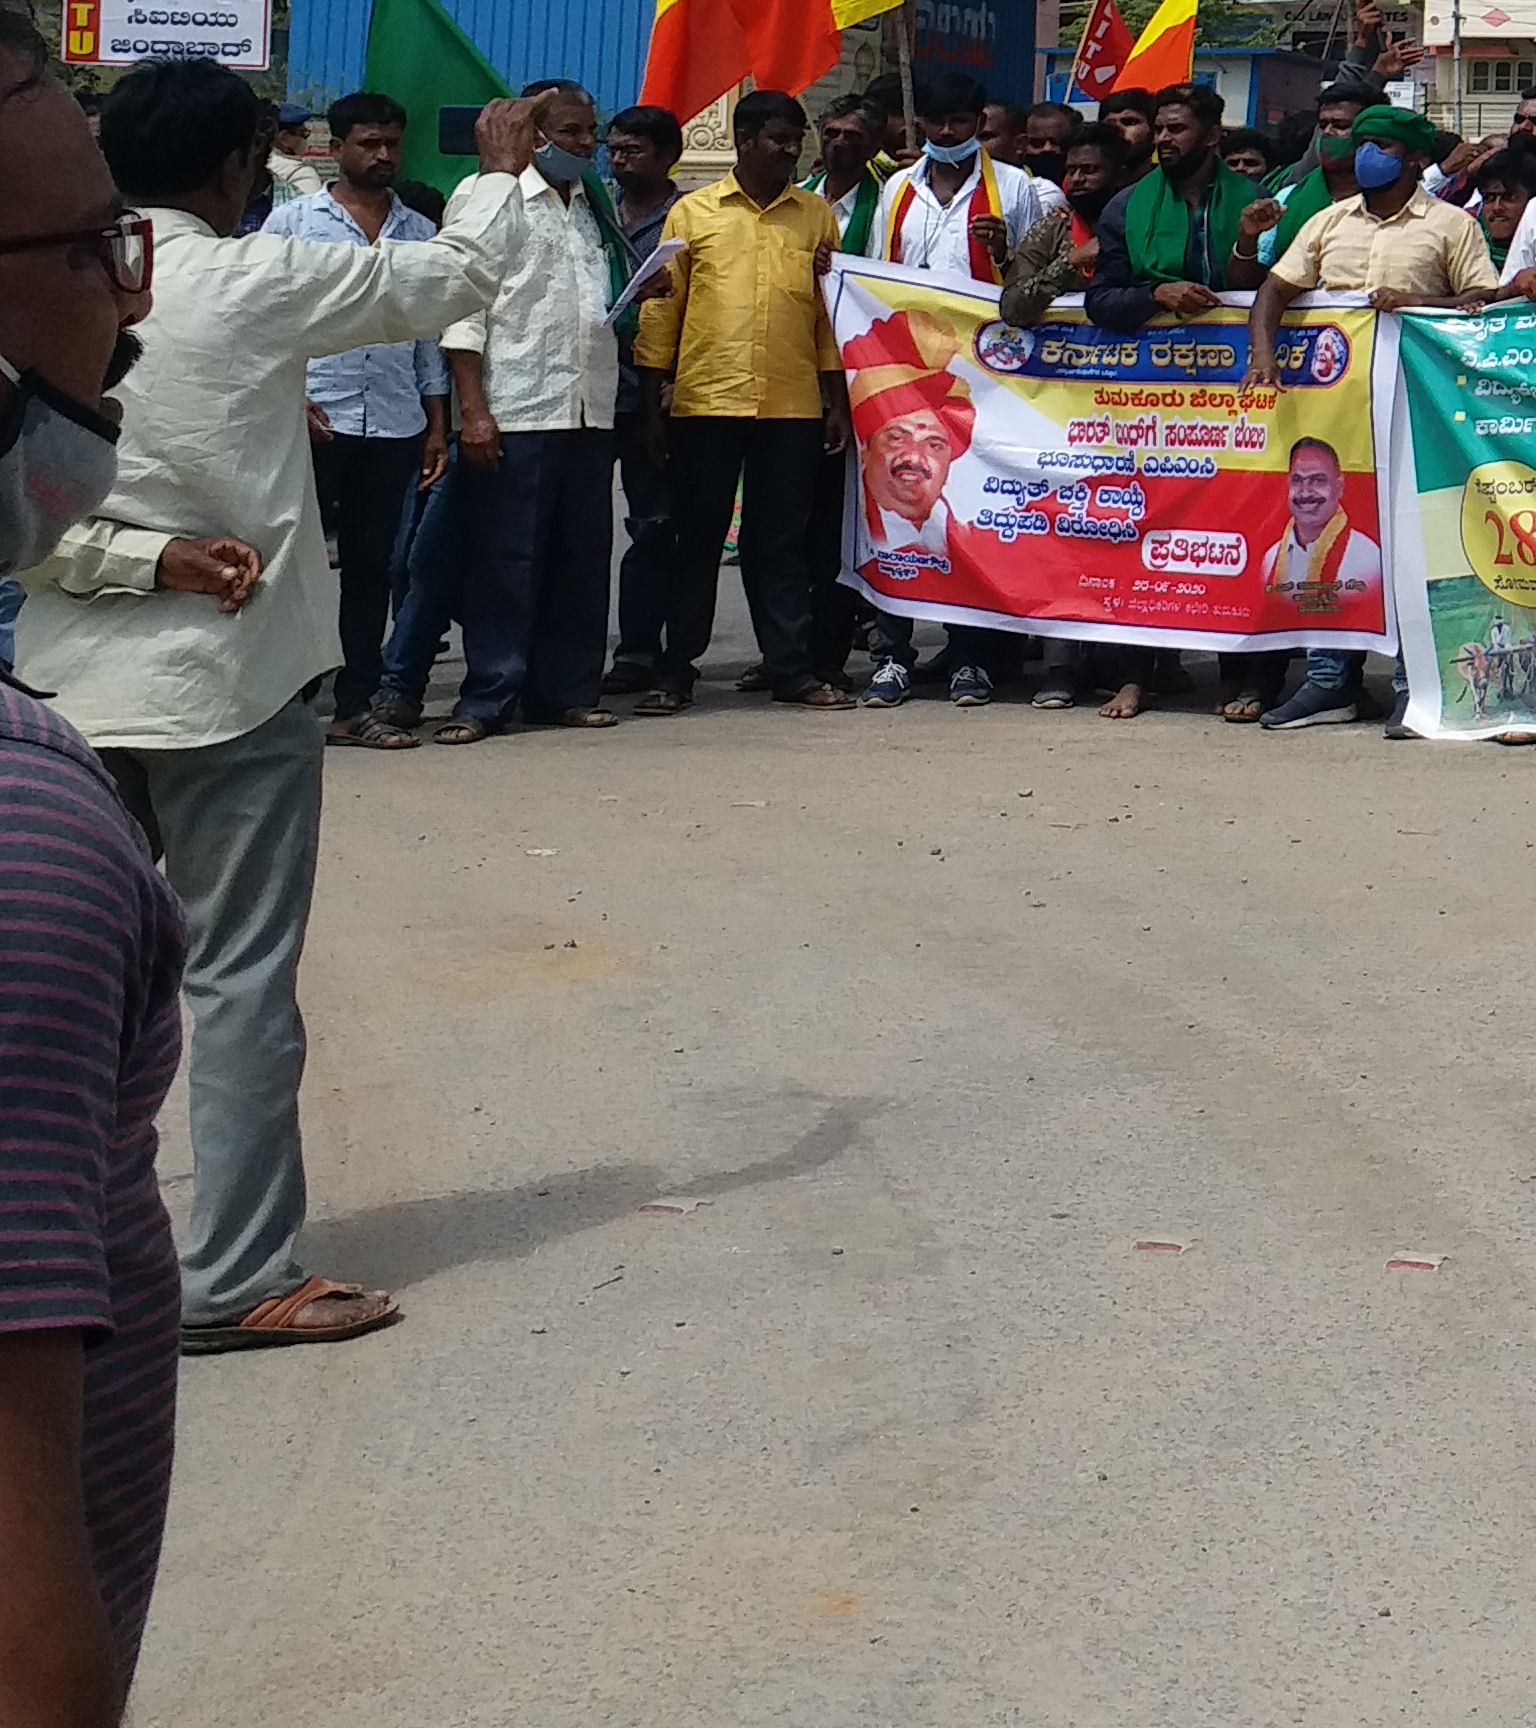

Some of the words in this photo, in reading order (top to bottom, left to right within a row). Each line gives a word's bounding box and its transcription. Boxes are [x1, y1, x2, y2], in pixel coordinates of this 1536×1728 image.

[1040, 336, 1139, 368] ಕರ್ನಾಟಕ
[1150, 336, 1237, 375] ರಕ್ಷಣಾ
[1094, 386, 1185, 409] ತುಮಕೂರು
[1189, 387, 1238, 416] ಜಿಲ್ಲಾ
[1165, 418, 1230, 448] ಸಂಪೂರ್ಣ
[982, 475, 1049, 506] ವಿದ್ಯುತ್
[976, 508, 1048, 540] ತಿದ್ದುಪಡಿ
[1150, 535, 1242, 571] ಪ್ರತಿಭಟನೆ
